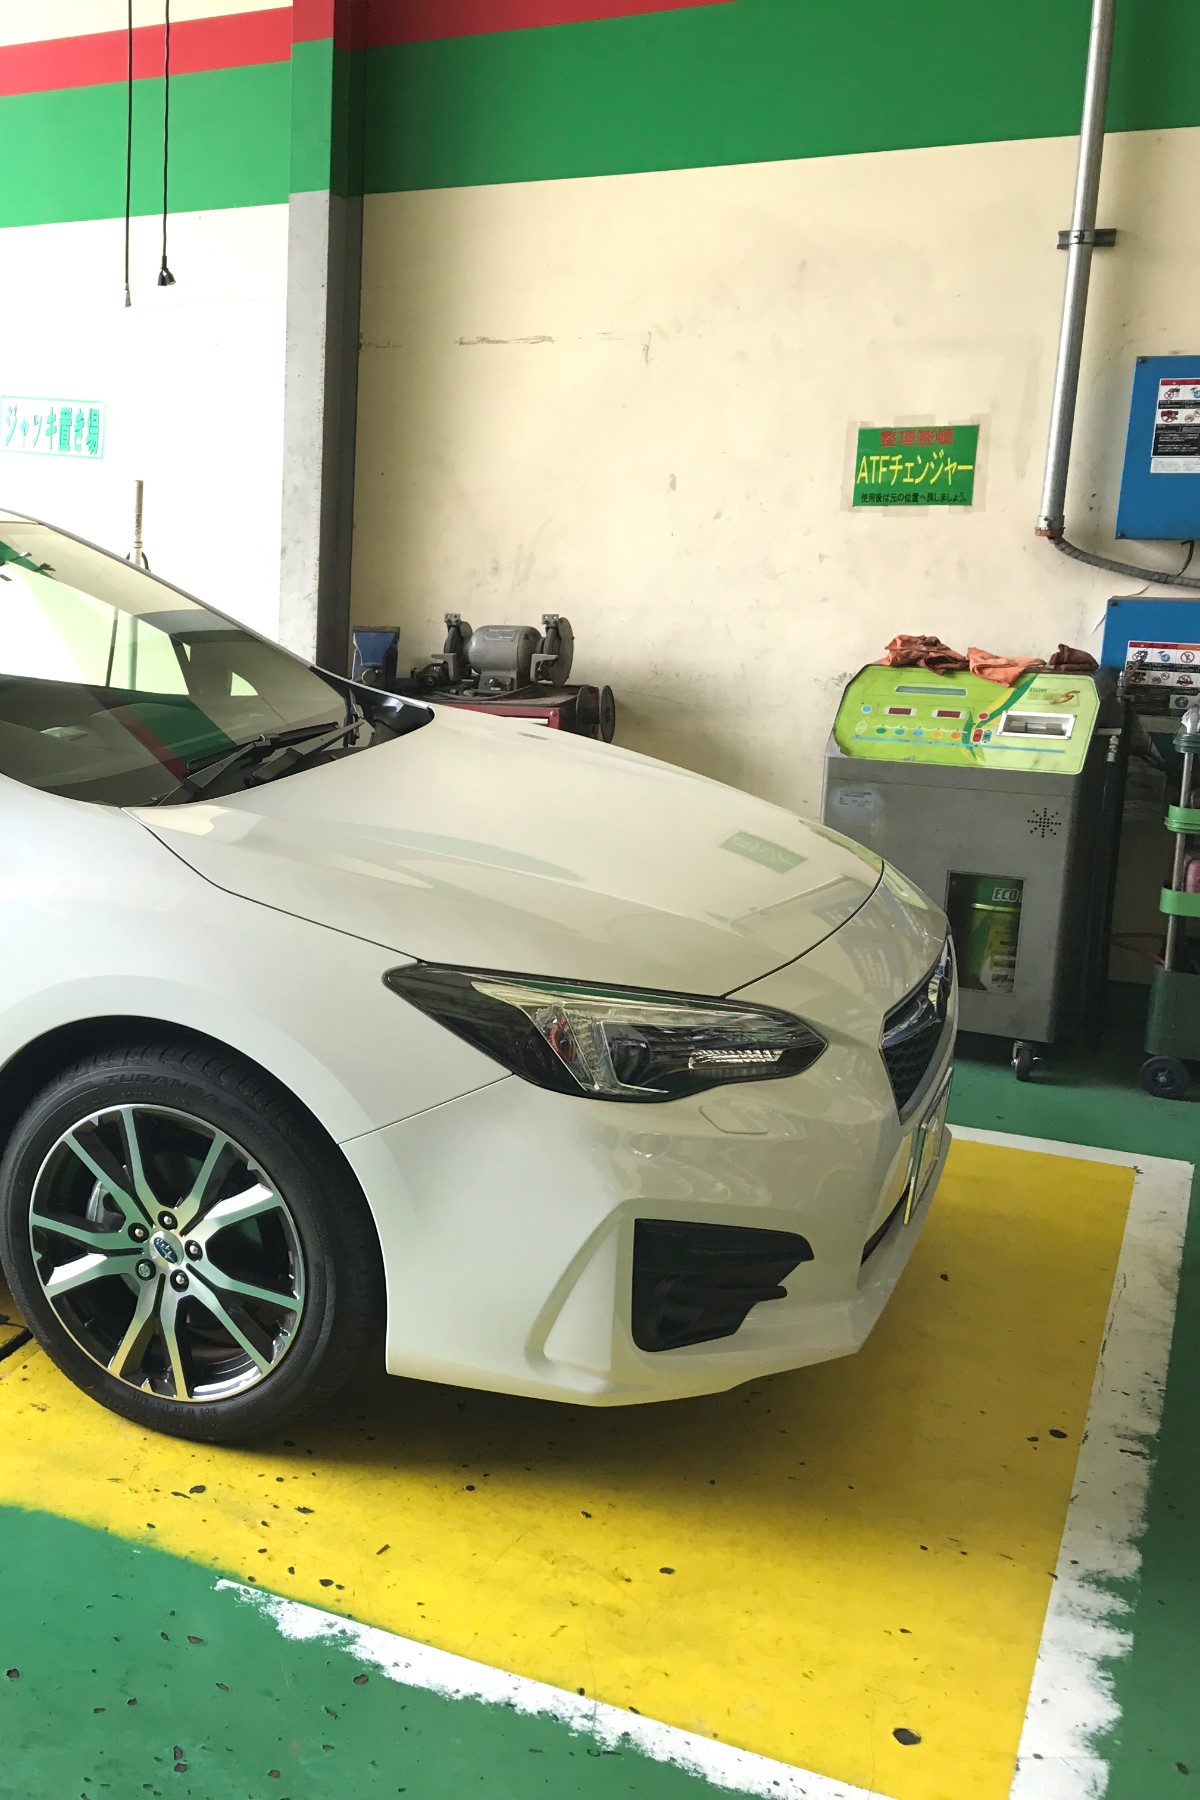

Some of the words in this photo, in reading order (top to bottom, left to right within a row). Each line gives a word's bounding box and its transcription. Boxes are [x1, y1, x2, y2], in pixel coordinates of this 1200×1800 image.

[5, 404, 100, 455] ジャッキ置き場
[879, 428, 955, 447] 整理整頓
[856, 449, 974, 486] ATFチェンジャー
